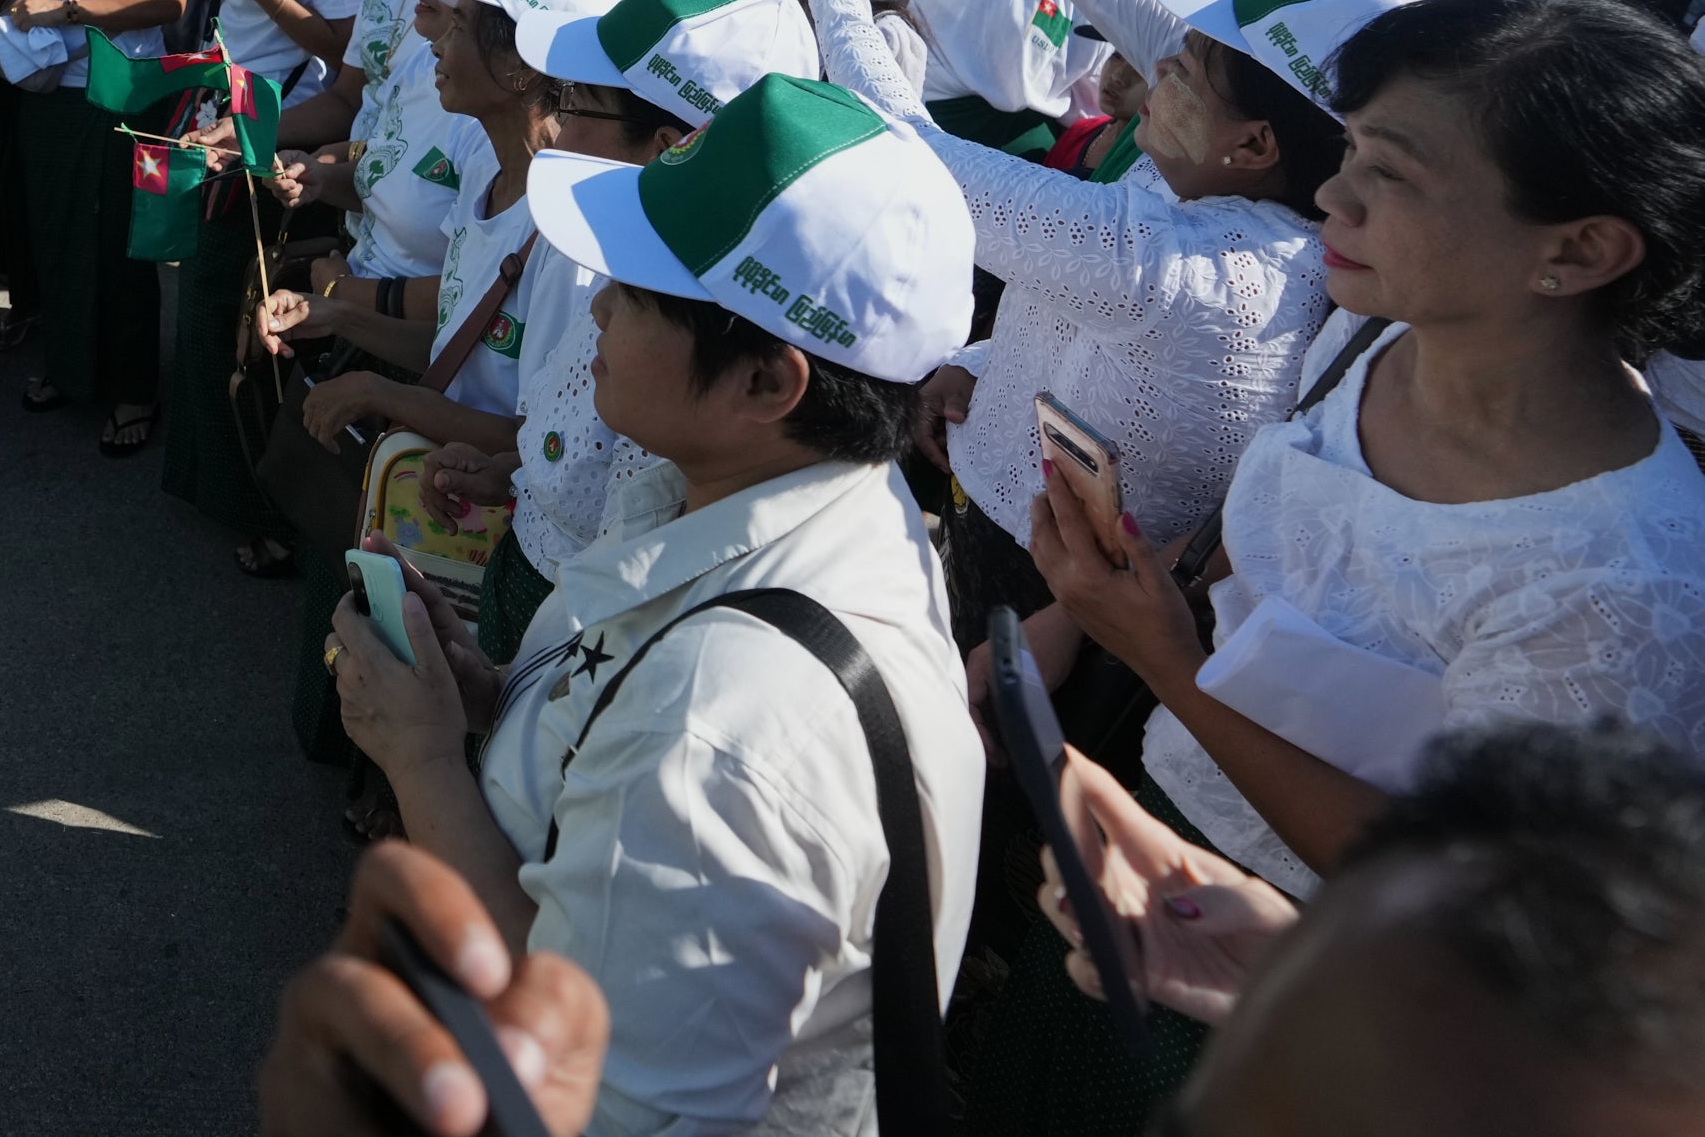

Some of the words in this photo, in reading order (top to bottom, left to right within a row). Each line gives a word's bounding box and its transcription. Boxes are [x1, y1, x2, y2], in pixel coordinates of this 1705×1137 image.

[732, 255, 790, 306] ပိုမိုခိုင်မာ
[785, 294, 857, 348] ပြည်မြန်မာ
